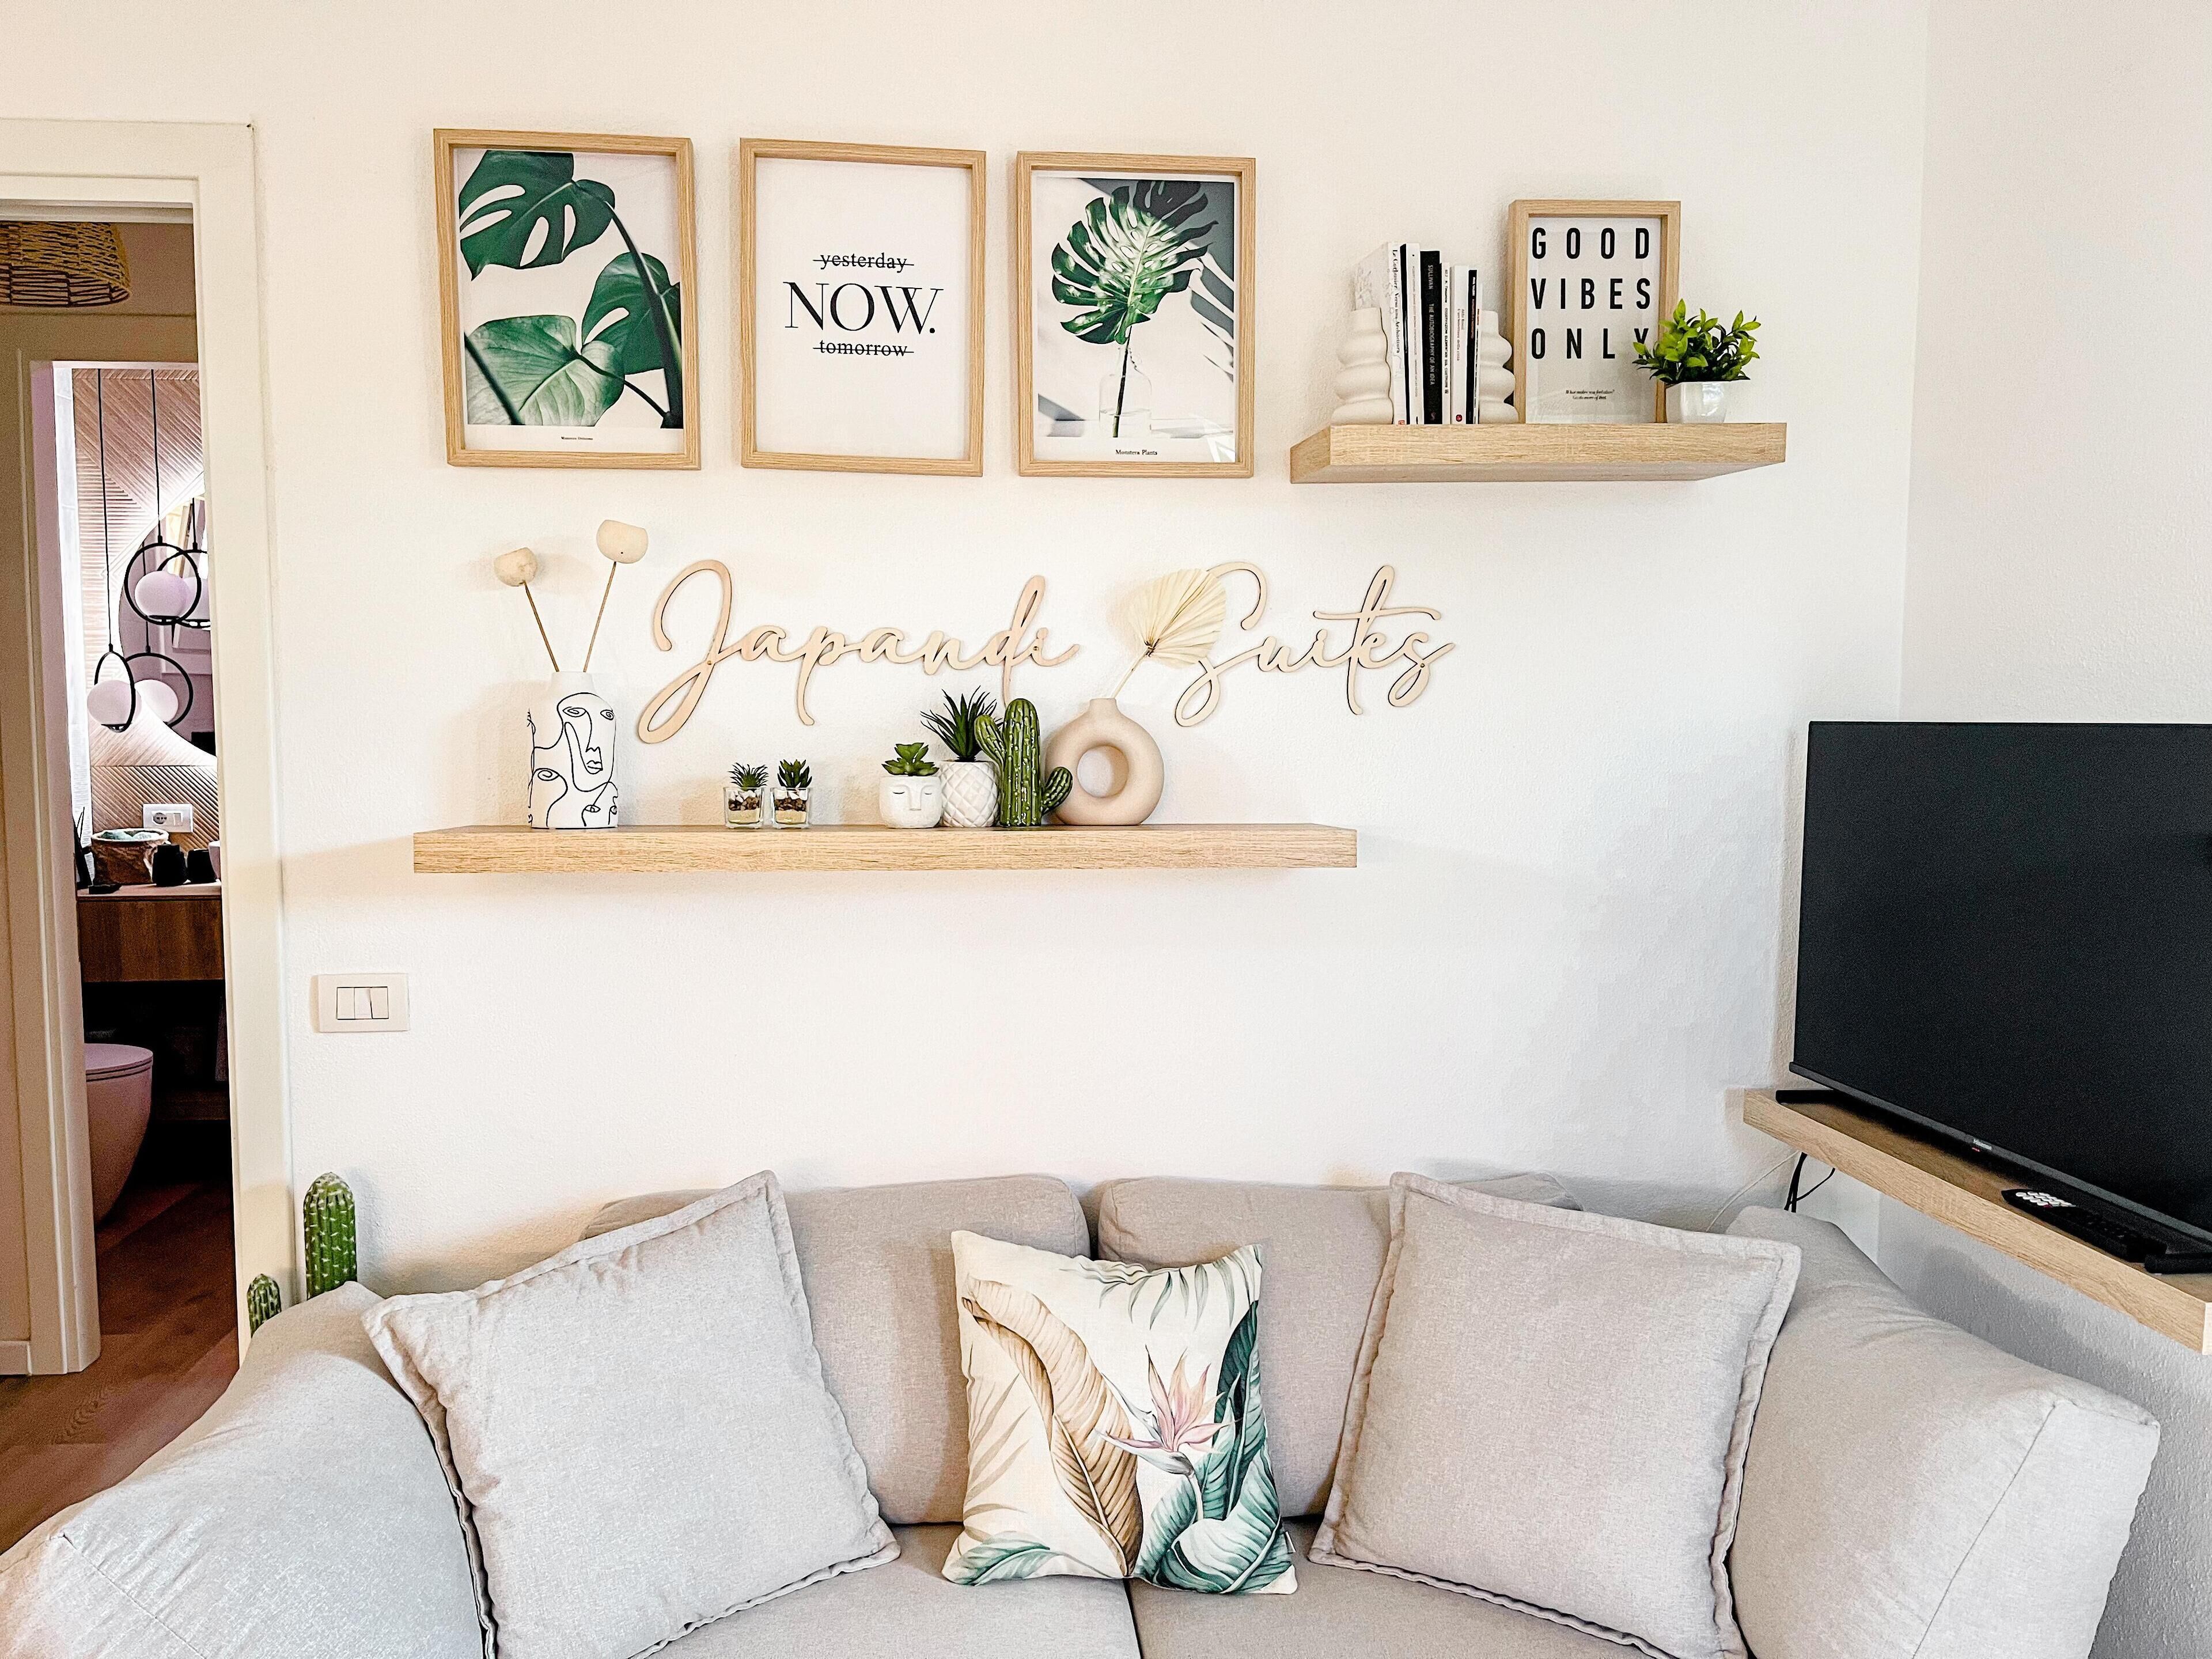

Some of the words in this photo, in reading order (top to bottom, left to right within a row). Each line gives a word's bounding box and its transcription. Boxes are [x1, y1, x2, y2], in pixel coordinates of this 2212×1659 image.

[1532, 227, 1649, 259] GOOD
[820, 252, 908, 274] yesterday
[782, 281, 944, 335] NOW.
[1531, 278, 1650, 309] VIBES
[819, 340, 908, 357] tomorrow
[1531, 328, 1649, 359] ONLY
[1430, 365, 1435, 373] AN
[638, 559, 1080, 744] Japandi
[1174, 561, 1456, 728] Suites
